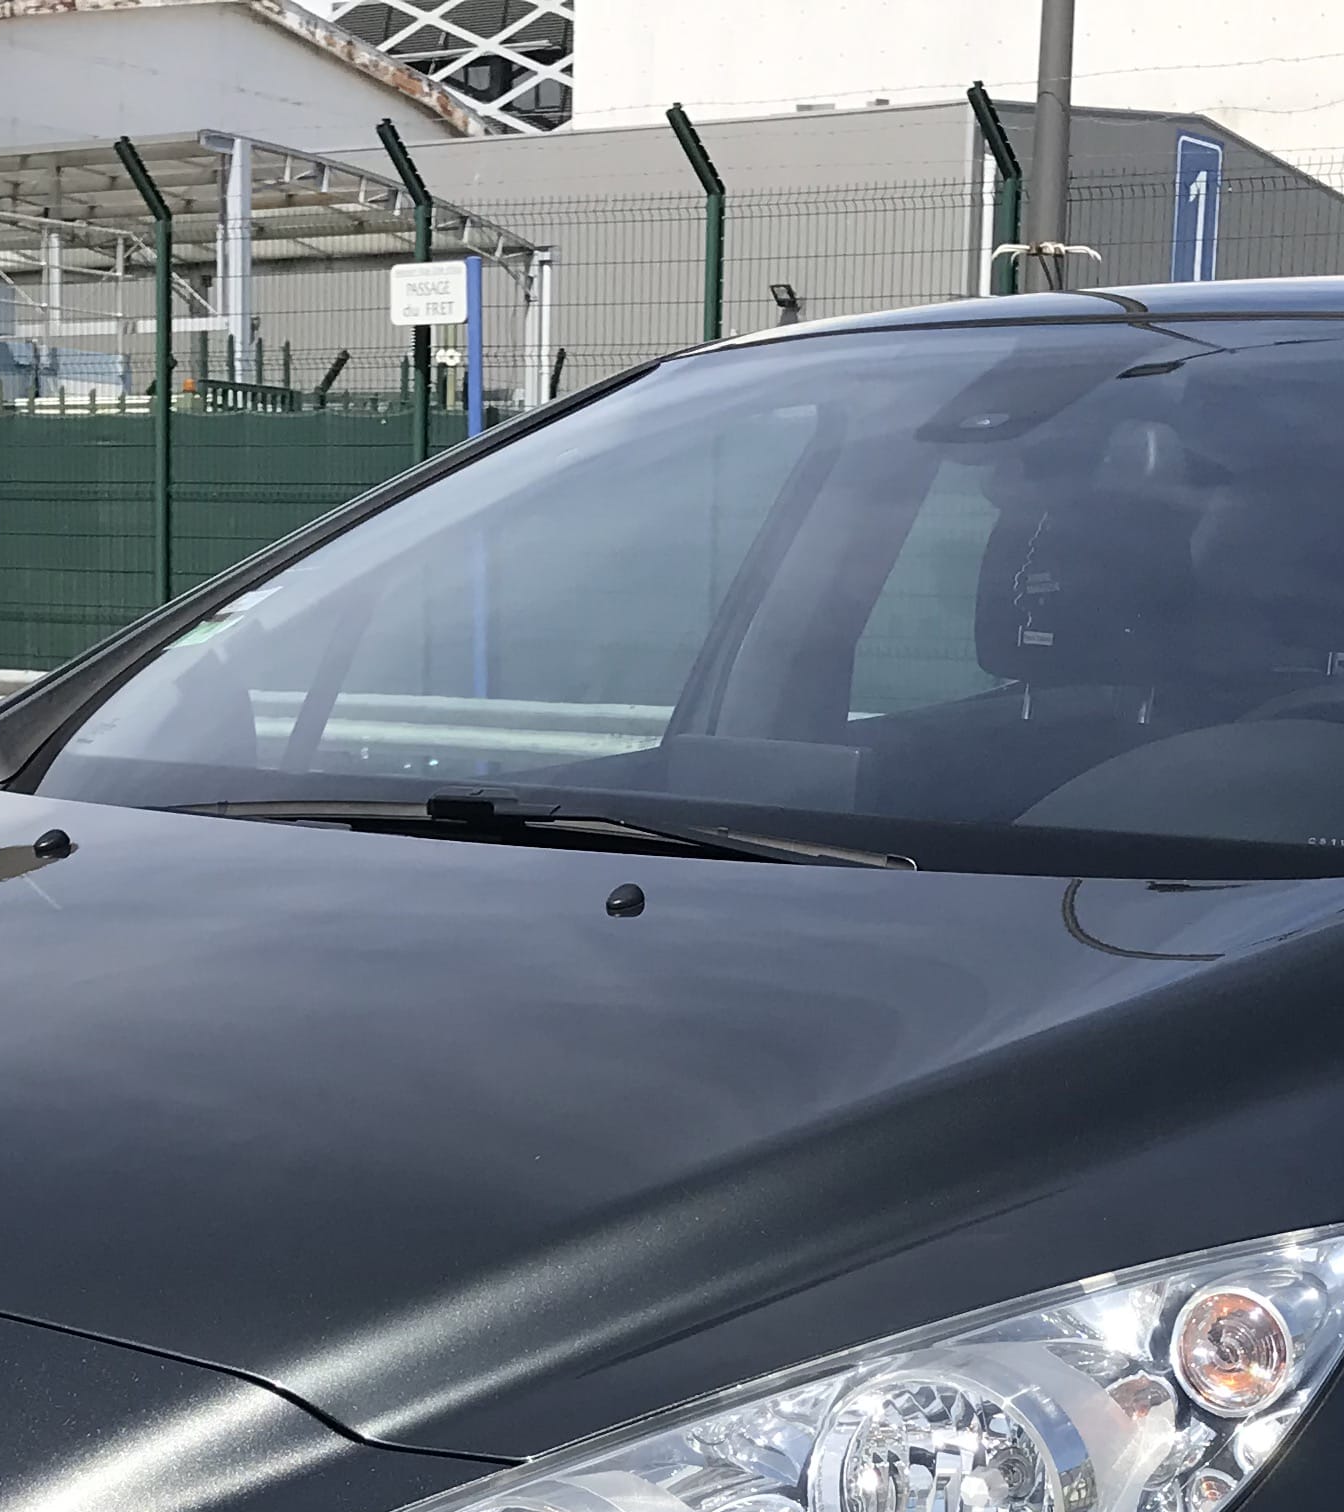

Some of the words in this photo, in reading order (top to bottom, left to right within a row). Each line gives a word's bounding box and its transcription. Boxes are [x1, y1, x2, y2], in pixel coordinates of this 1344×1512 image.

[1188, 170, 1208, 282] 1
[406, 280, 451, 297] PASSAGE
[425, 301, 455, 316] FRET
